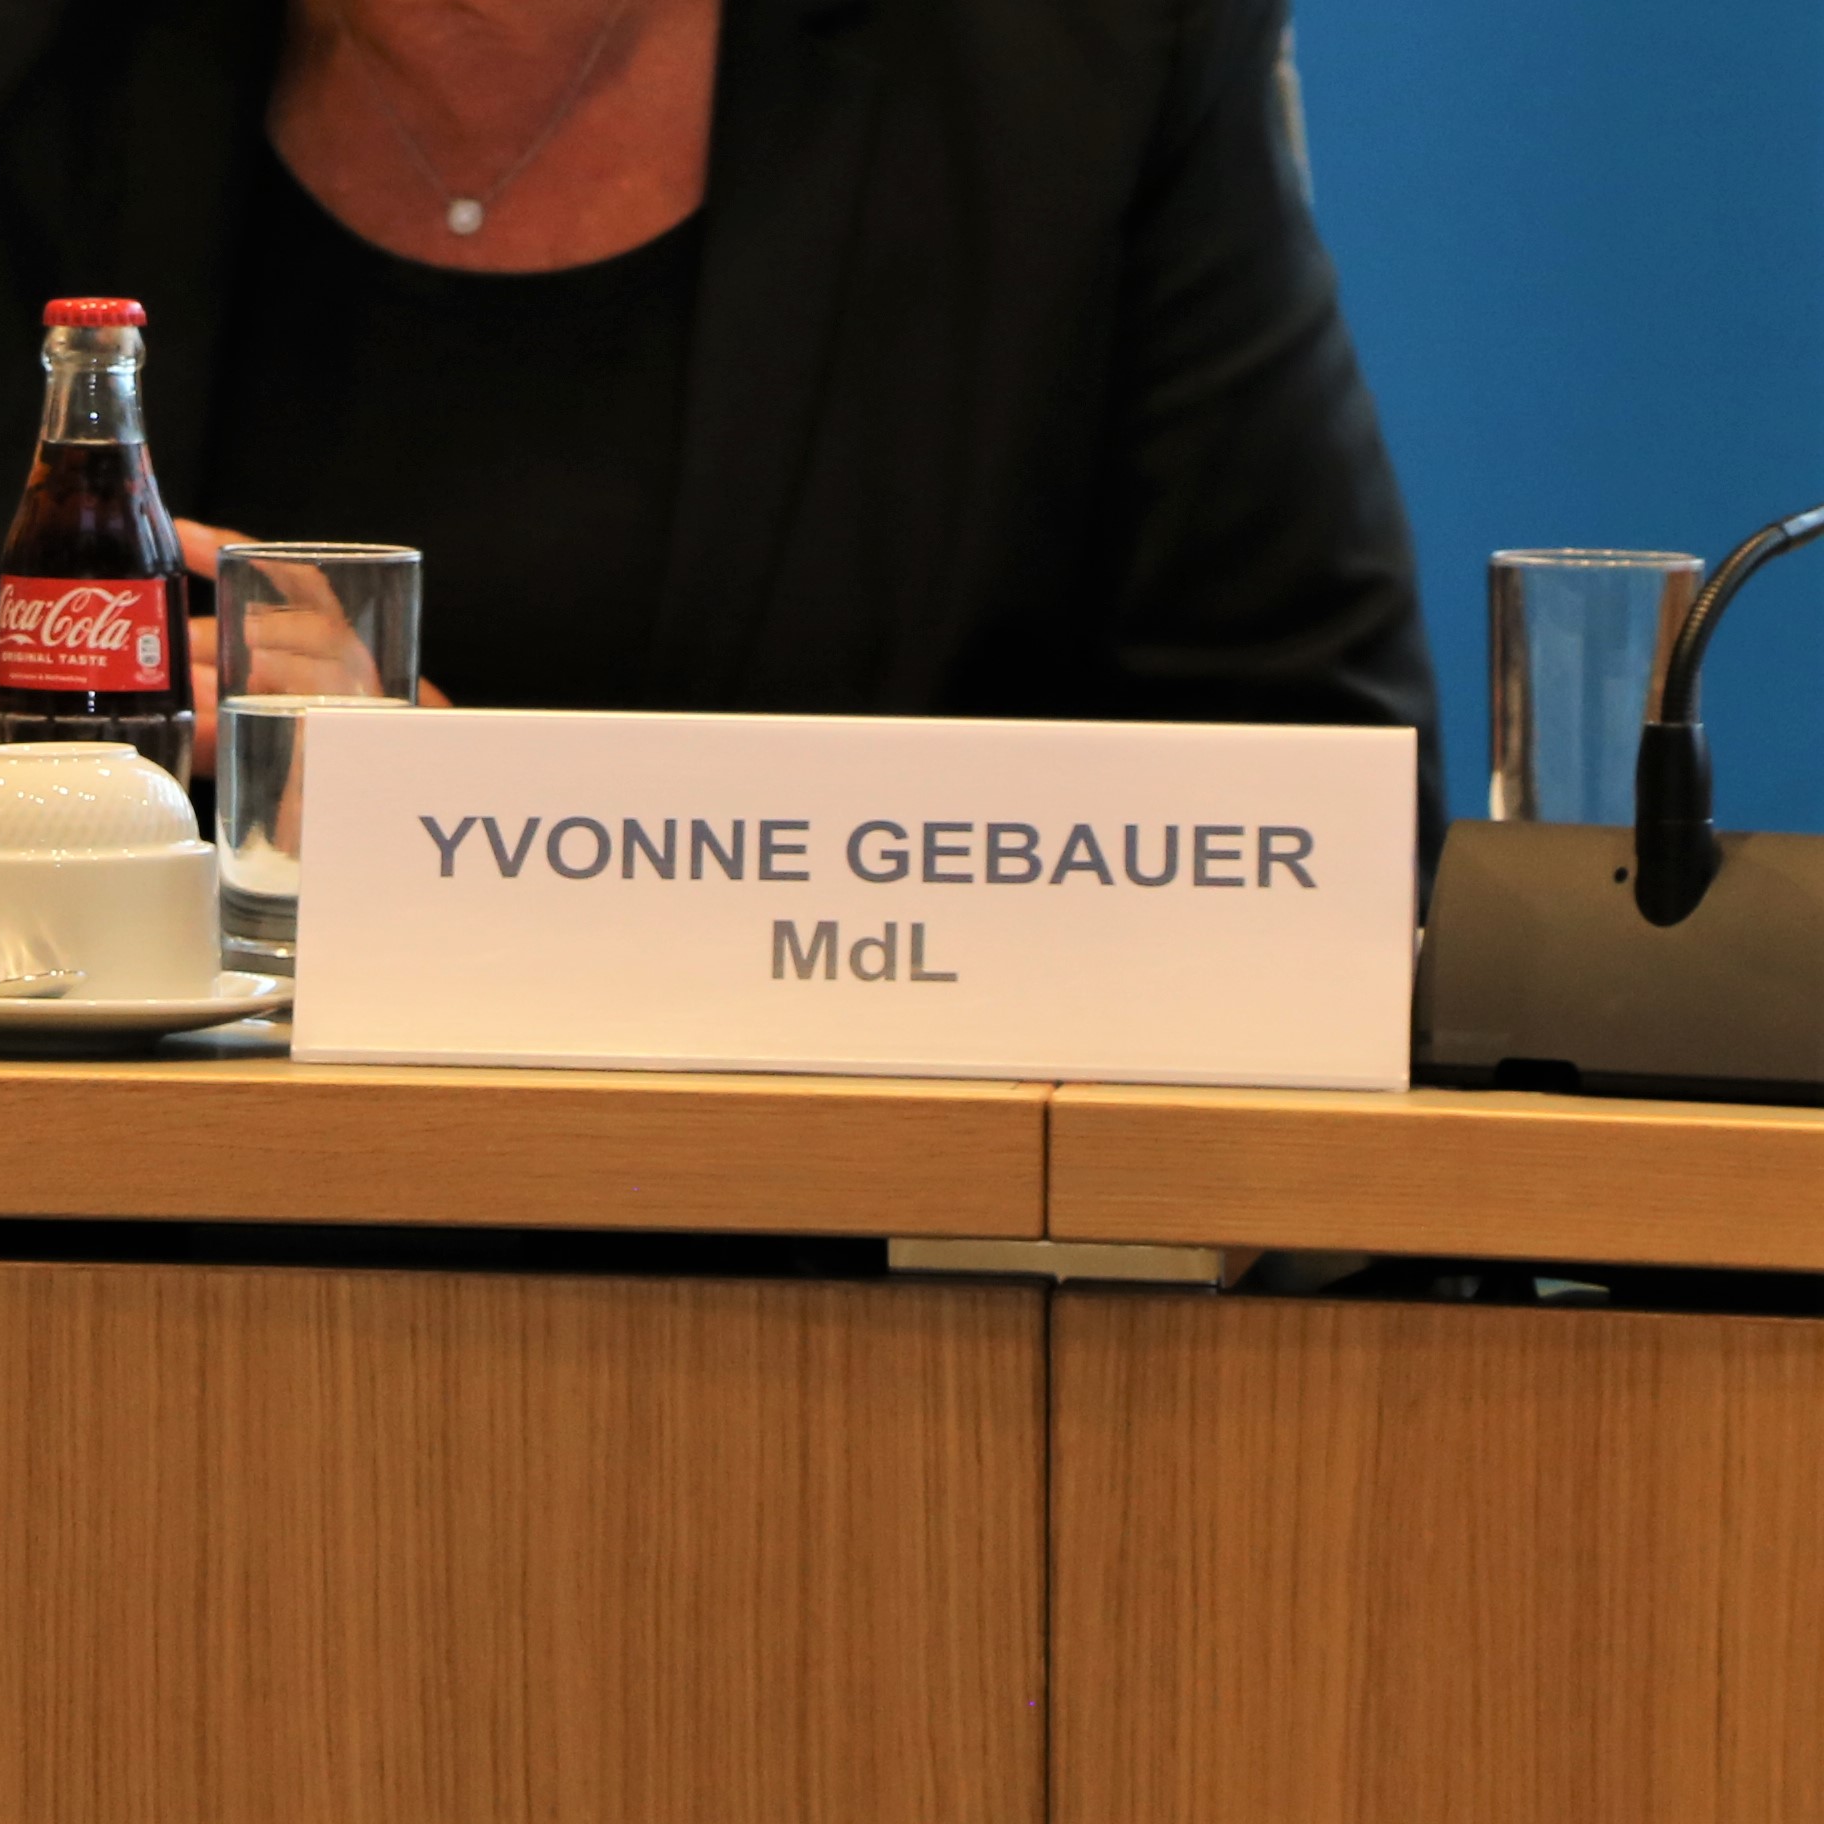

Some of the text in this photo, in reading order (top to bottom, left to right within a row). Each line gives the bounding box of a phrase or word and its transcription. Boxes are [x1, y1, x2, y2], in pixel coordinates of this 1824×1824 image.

[58, 653, 109, 668] TASTE
[419, 816, 1317, 889] YVONNE GEBAUER
[772, 919, 959, 983] MdL
